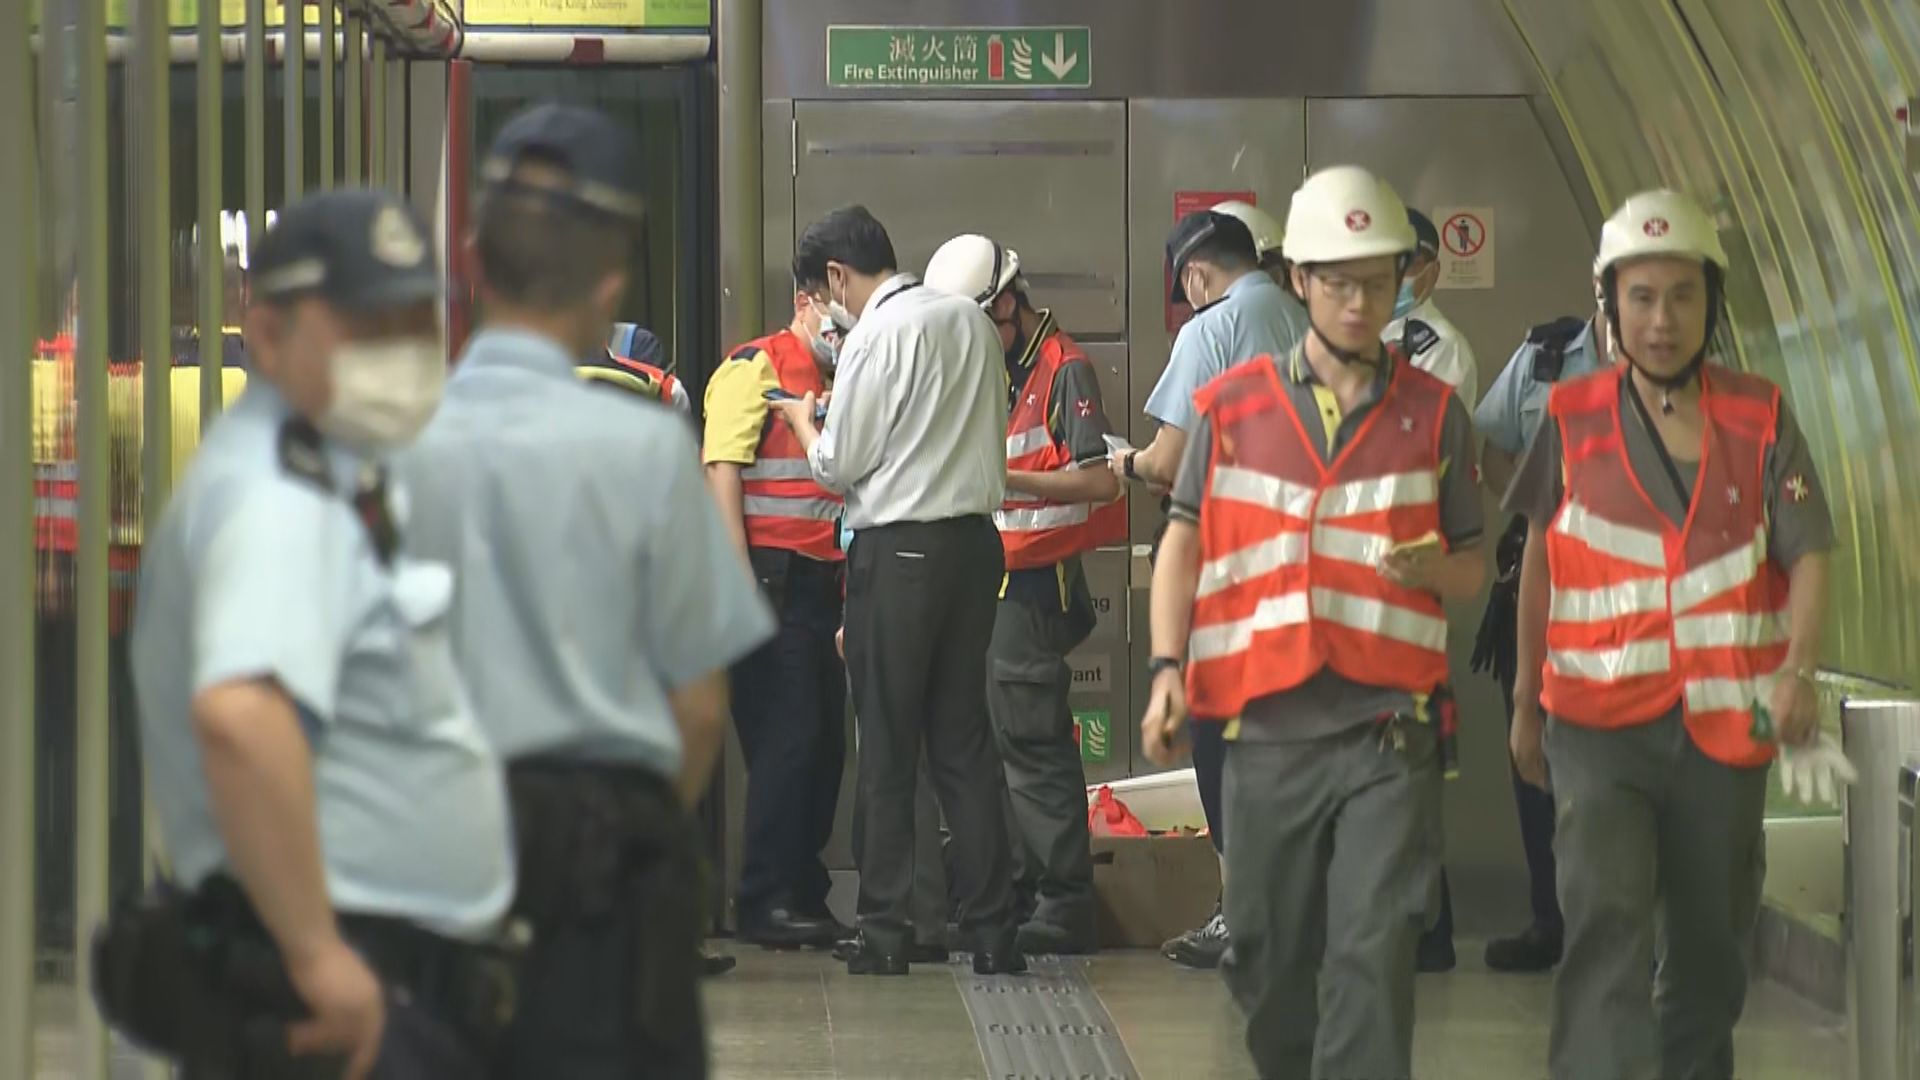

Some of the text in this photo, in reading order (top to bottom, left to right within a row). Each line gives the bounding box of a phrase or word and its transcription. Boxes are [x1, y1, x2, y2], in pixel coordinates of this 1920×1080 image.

[889, 34, 977, 63] 滅火筒
[844, 64, 979, 83] Fire Extinguisher
[1091, 597, 1110, 613] ng
[1073, 667, 1102, 682] ant
